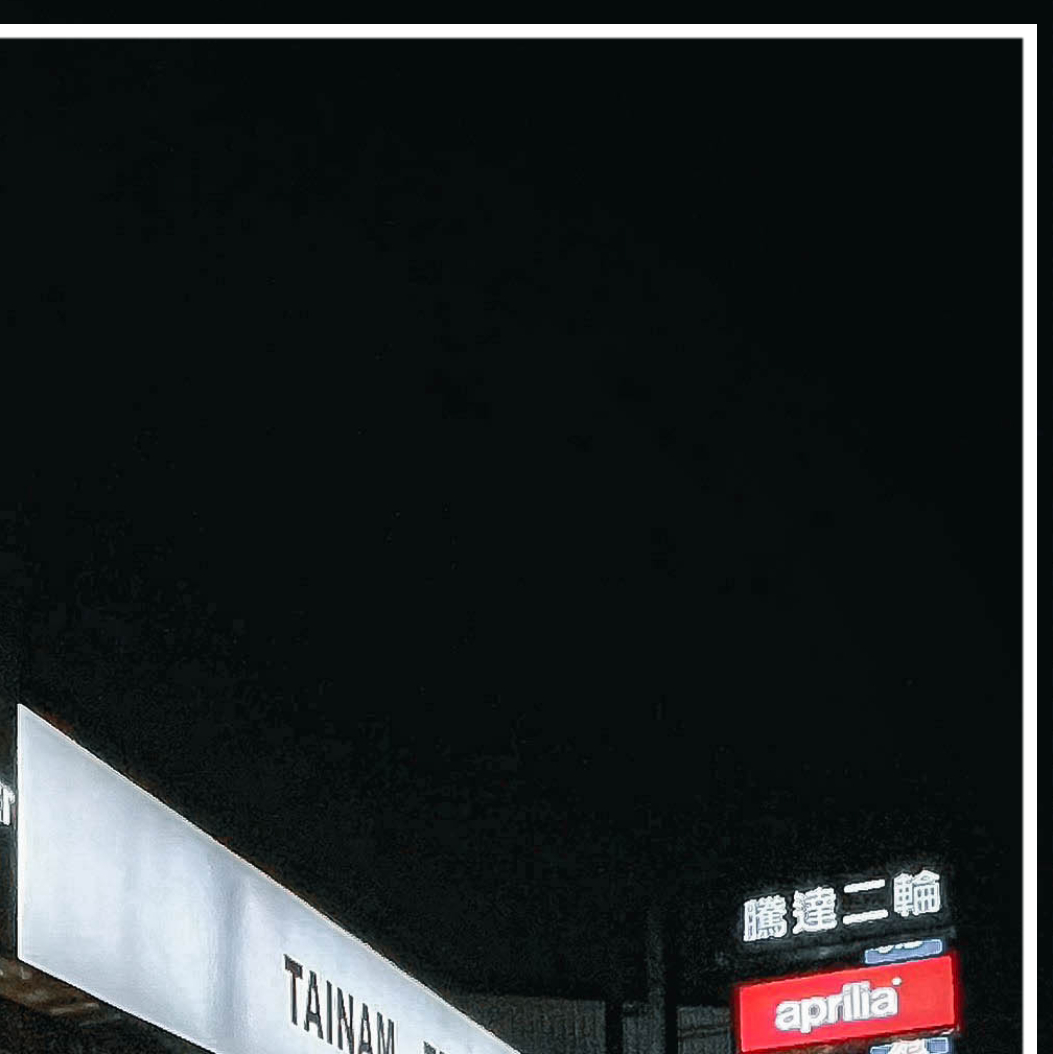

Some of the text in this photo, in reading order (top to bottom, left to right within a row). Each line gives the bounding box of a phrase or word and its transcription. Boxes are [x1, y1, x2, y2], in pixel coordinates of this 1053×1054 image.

[742, 868, 942, 942] 騰達二輪
[774, 980, 898, 1034] aprilia
